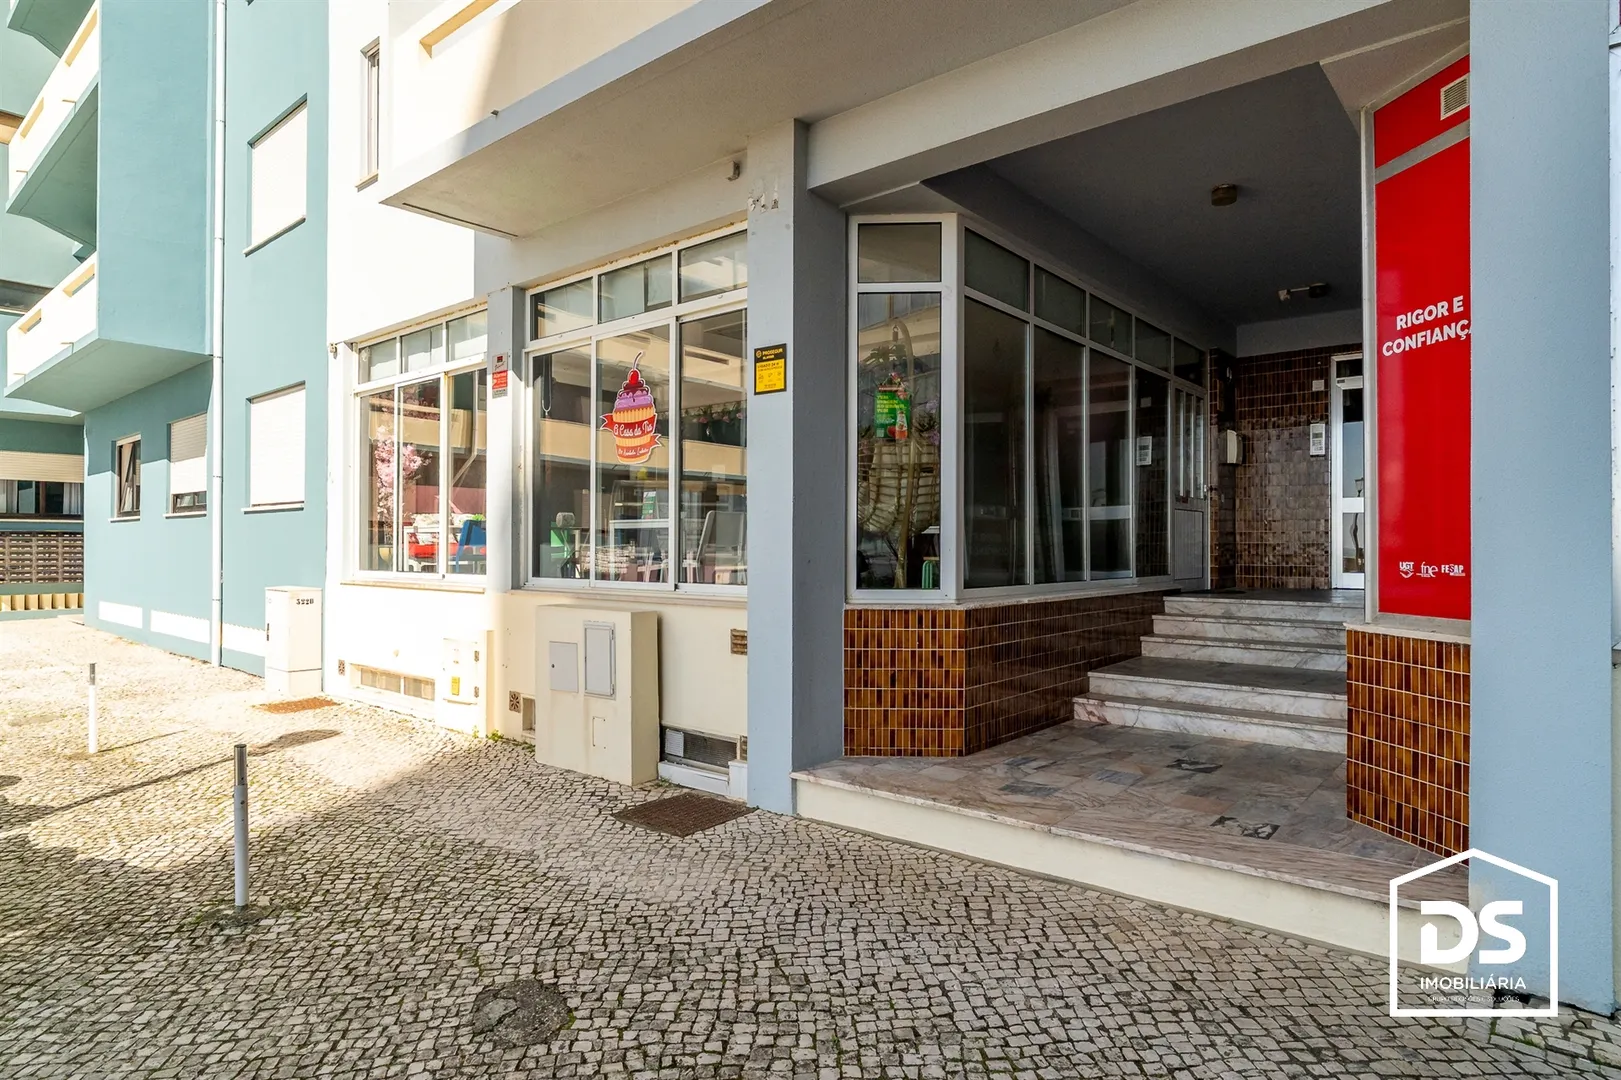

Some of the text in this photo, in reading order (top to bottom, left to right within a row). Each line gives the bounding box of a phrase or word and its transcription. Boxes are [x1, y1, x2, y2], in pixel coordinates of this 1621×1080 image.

[1396, 295, 1464, 330] RIGOR E
[1382, 319, 1471, 356] CONFIANÇ
[1399, 561, 1414, 570] UGT
[1441, 564, 1464, 574] FESAP
